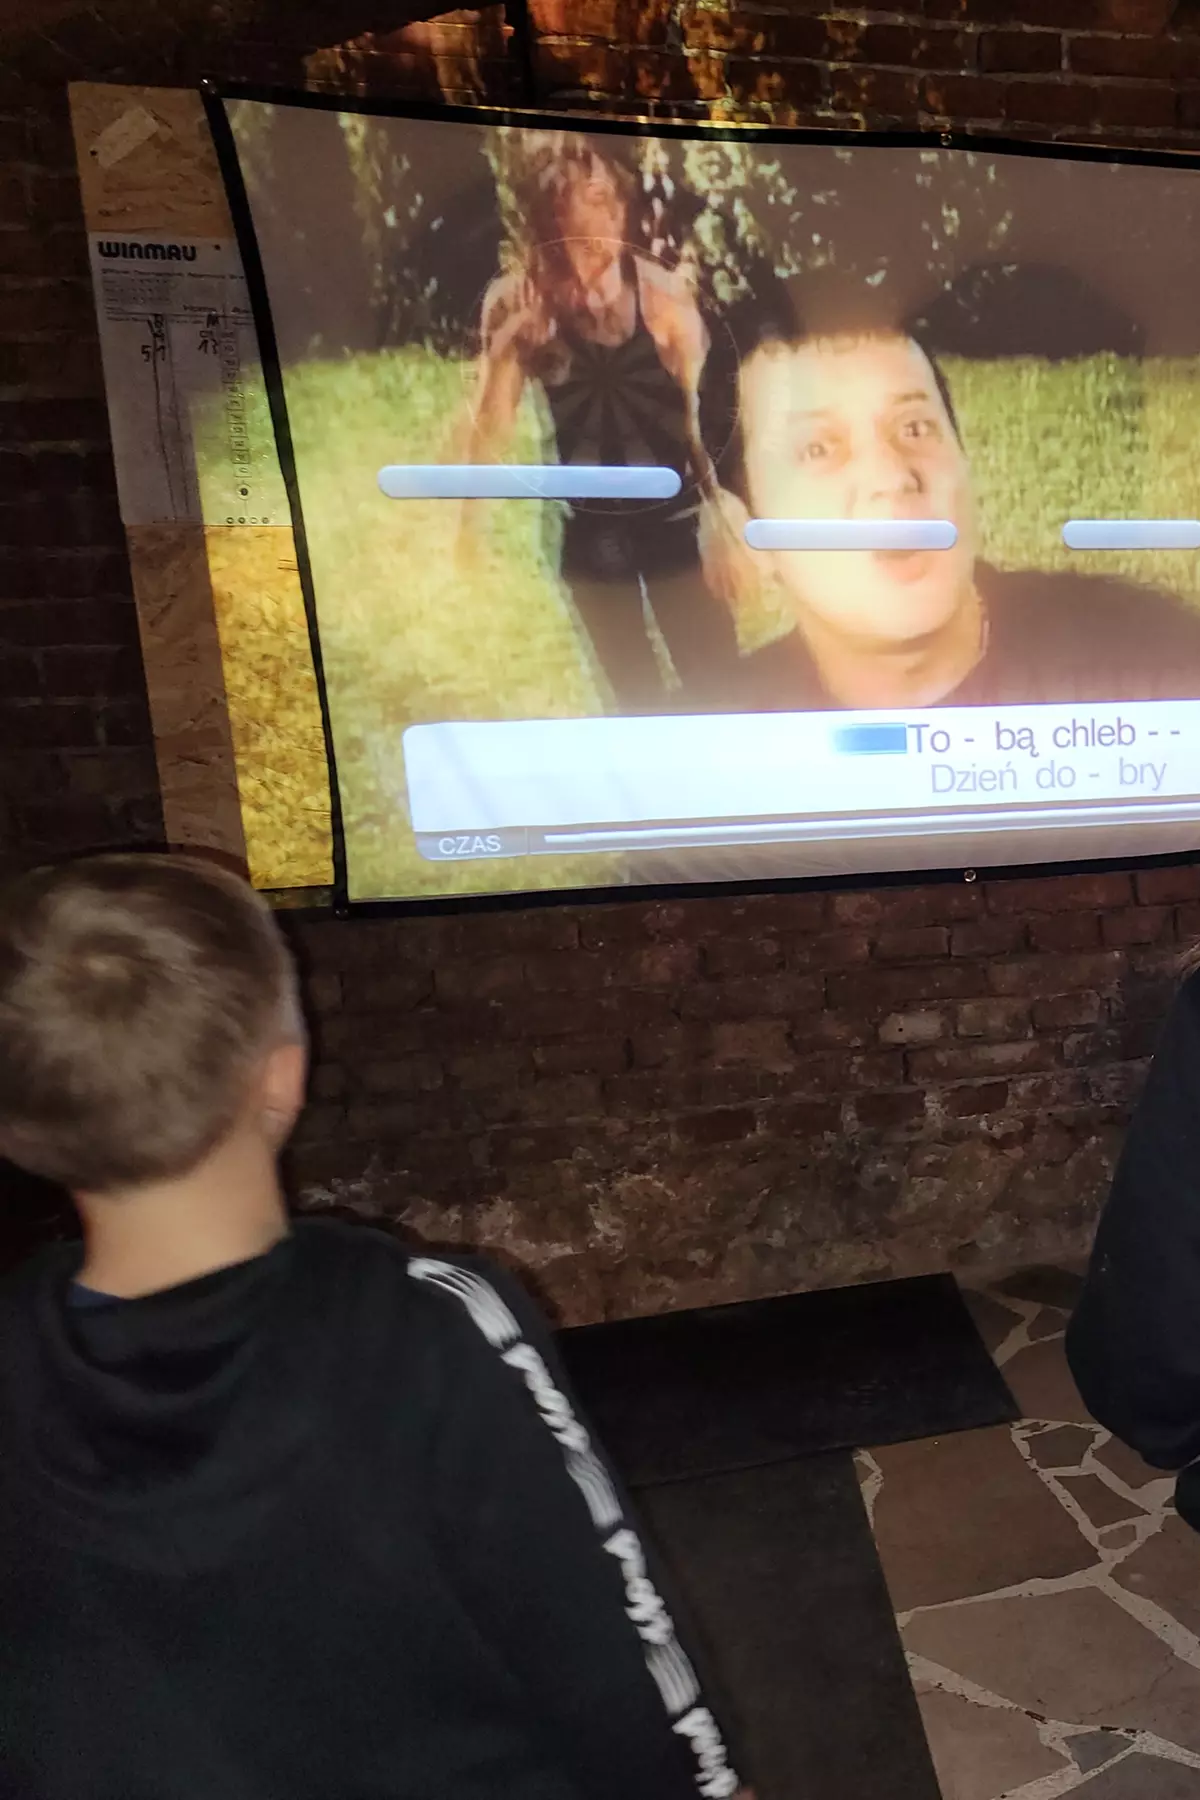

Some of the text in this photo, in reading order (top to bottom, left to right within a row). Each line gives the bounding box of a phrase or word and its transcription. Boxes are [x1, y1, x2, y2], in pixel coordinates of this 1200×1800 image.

[98, 241, 197, 262] WINMAU
[907, 723, 951, 754] To
[995, 720, 1040, 758] bą
[1052, 717, 1137, 749] chleb
[930, 760, 1018, 794] Dzień
[1036, 760, 1076, 790] do
[1119, 757, 1168, 790] bry
[438, 835, 502, 855] CZAS
